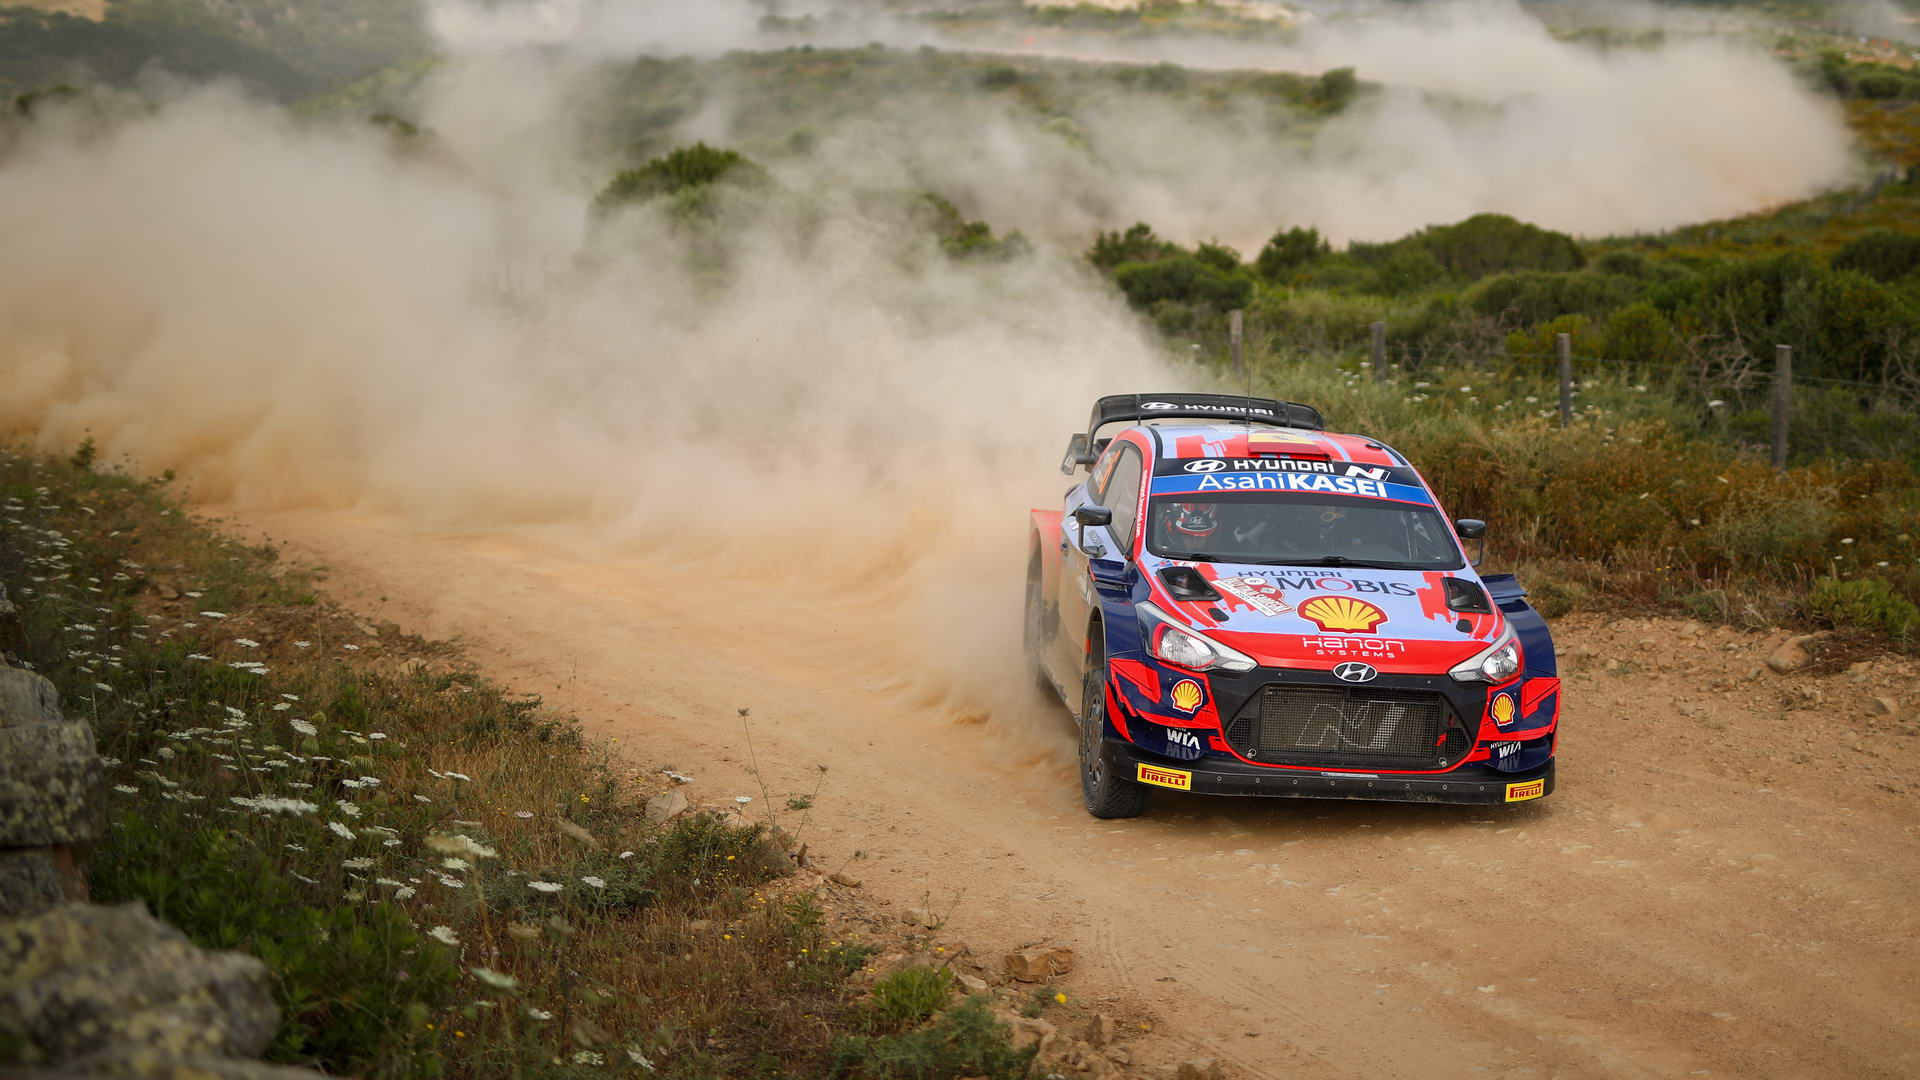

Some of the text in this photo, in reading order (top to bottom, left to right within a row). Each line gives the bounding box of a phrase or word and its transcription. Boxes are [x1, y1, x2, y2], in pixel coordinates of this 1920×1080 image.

[1184, 403, 1274, 416] HYUNDAI
[1233, 459, 1335, 473] HYUNDAI
[1237, 570, 1343, 579] HYUNDAI
[1275, 577, 1418, 597] MOBIS
[1316, 649, 1395, 659] SYSTEMS
[1141, 767, 1187, 786] PIRELLI
[1509, 783, 1542, 798] PIRELLI
